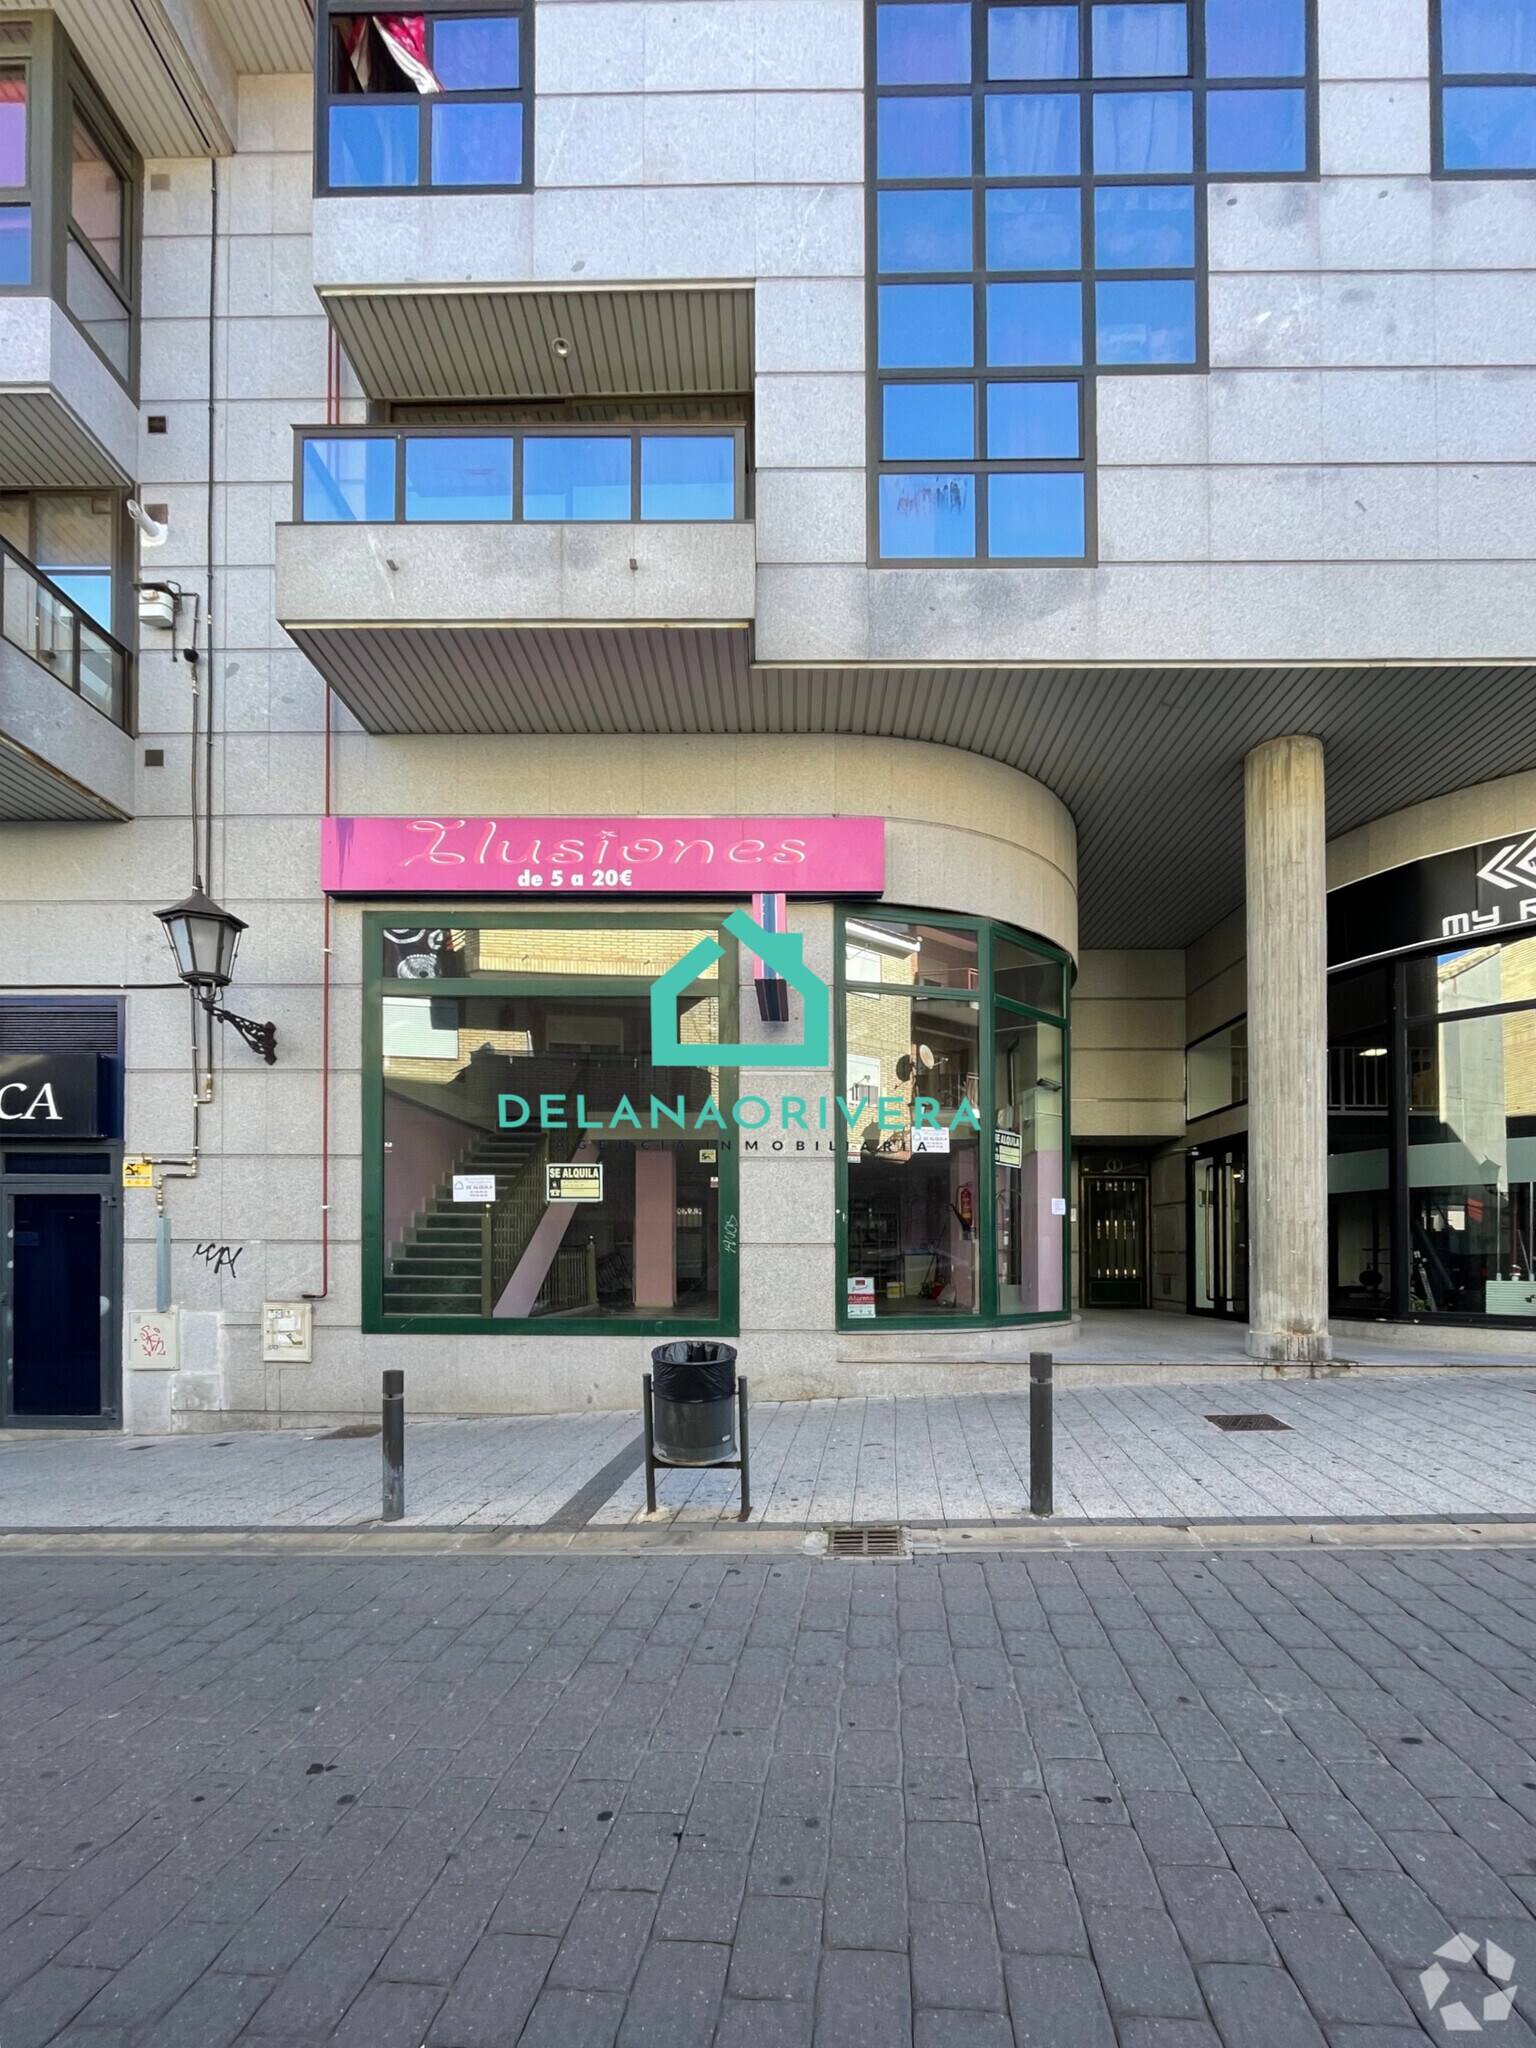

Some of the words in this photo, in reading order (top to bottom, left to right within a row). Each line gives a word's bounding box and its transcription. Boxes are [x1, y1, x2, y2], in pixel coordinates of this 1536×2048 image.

[517, 869, 543, 887] de
[550, 869, 564, 887] 5
[571, 872, 584, 887] a
[591, 869, 633, 887] 20€
[0, 1082, 63, 1120] CA
[549, 1167, 561, 1179] SE
[562, 1167, 599, 1179] ALQUILA
